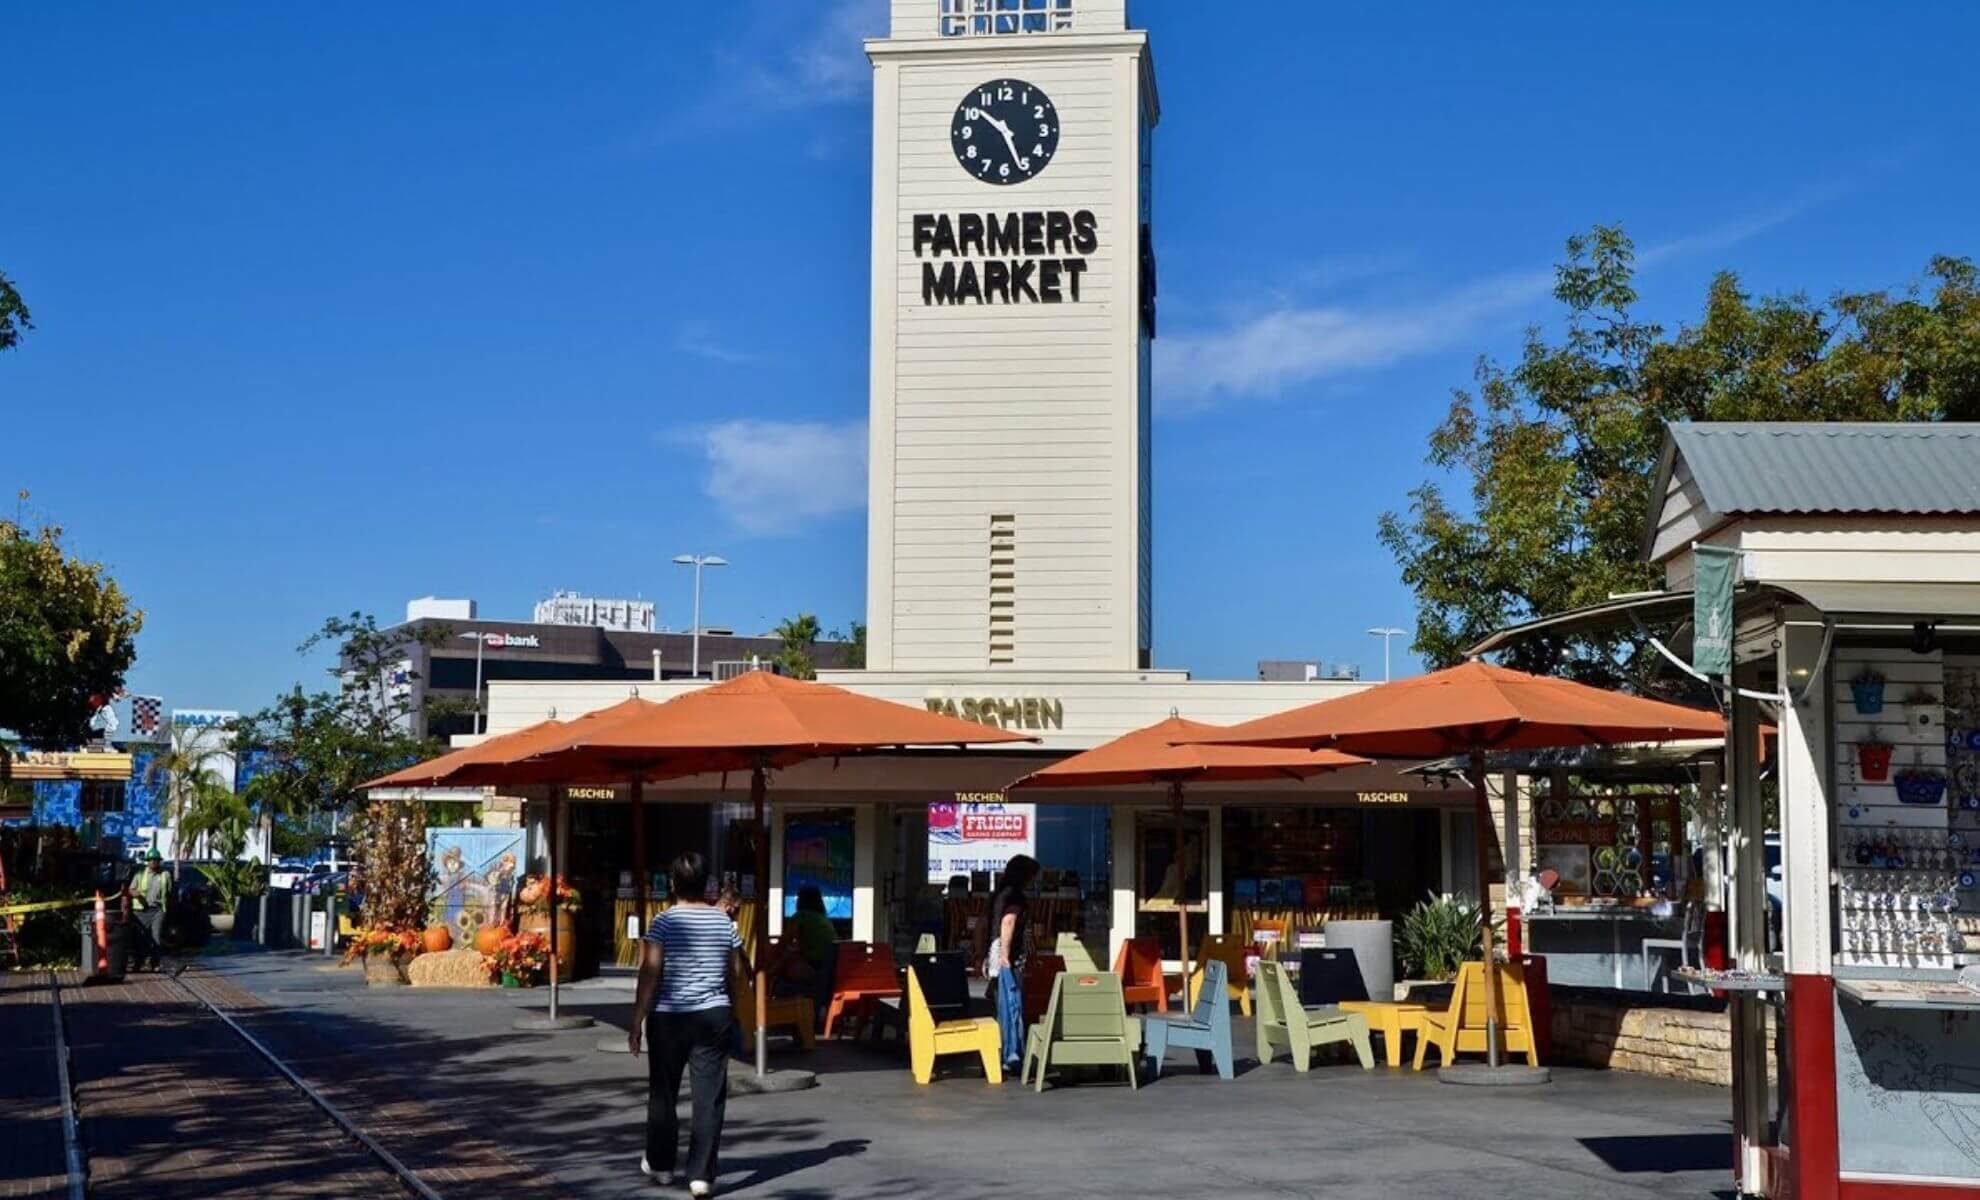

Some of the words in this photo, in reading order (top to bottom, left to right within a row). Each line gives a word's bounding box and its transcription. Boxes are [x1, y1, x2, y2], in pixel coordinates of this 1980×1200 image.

[981, 93, 992, 106] 11
[998, 88, 1013, 101] 12
[1022, 92, 1027, 105] 1
[965, 107, 979, 120] 10
[1034, 105, 1044, 119] 2
[962, 126, 972, 139] 9
[1039, 124, 1049, 137] 3
[966, 145, 977, 158] 8
[1032, 144, 1043, 157] 4
[982, 159, 992, 172] 7
[999, 163, 1010, 176] 6
[1021, 157, 1030, 170] 5
[913, 210, 1097, 257] FARMERS
[922, 258, 1087, 305] MARKET
[924, 697, 1063, 730] TASCHEN
[568, 788, 614, 799] TASCHEN
[955, 792, 1004, 802] TASCHEN
[1356, 792, 1408, 803] TASCHEN
[966, 815, 1023, 830] FRISCO
